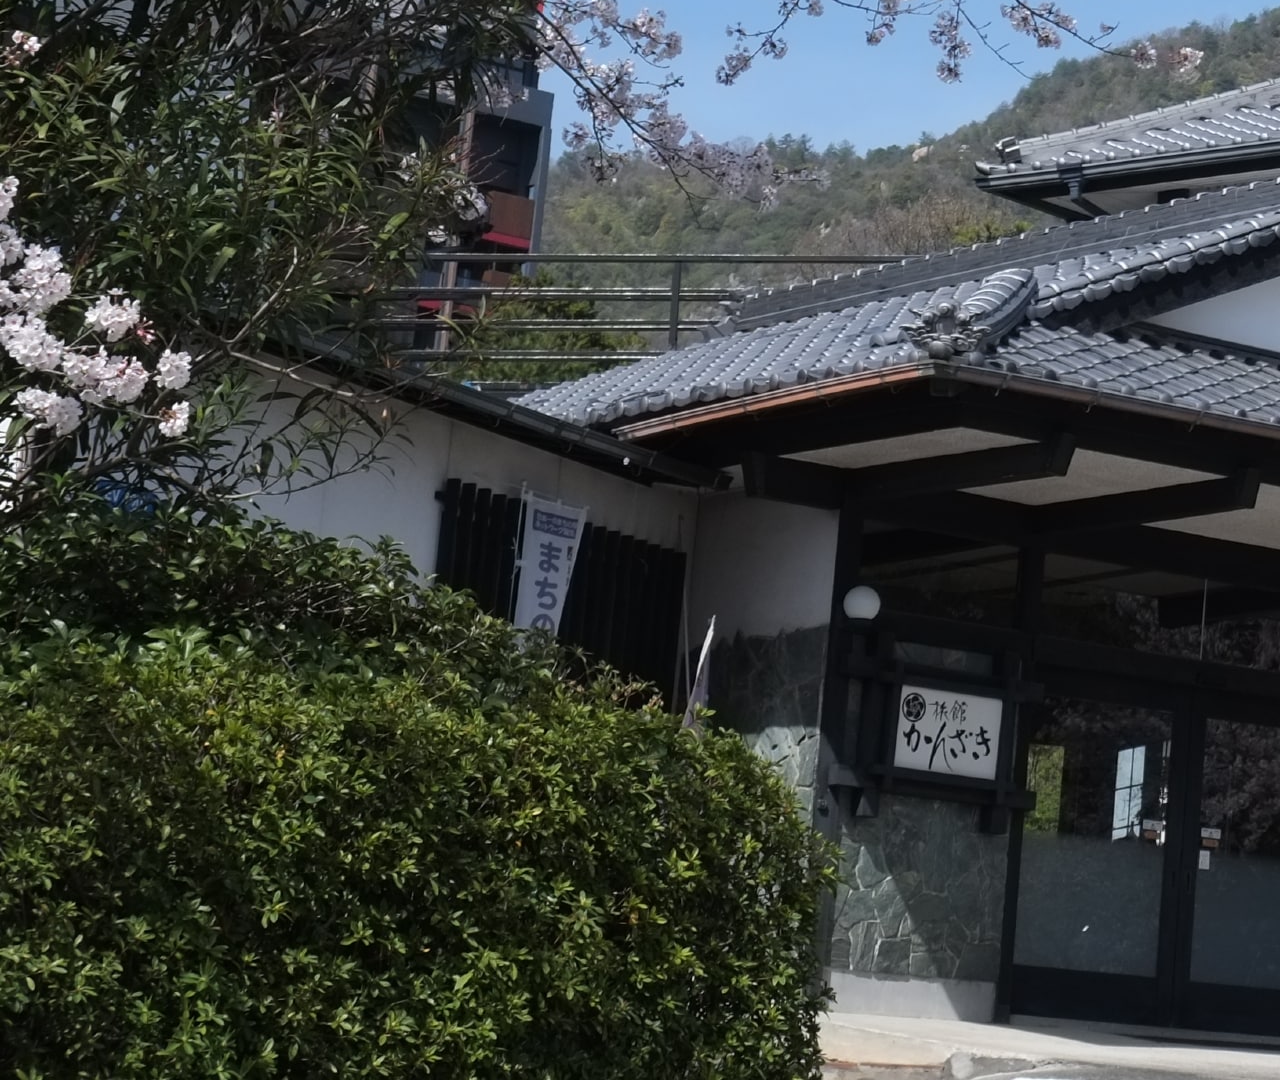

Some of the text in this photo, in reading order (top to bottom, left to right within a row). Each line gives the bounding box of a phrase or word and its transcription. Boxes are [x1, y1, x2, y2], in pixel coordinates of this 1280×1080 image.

[928, 700, 968, 725] 旅館
[903, 721, 991, 772] かんざき
